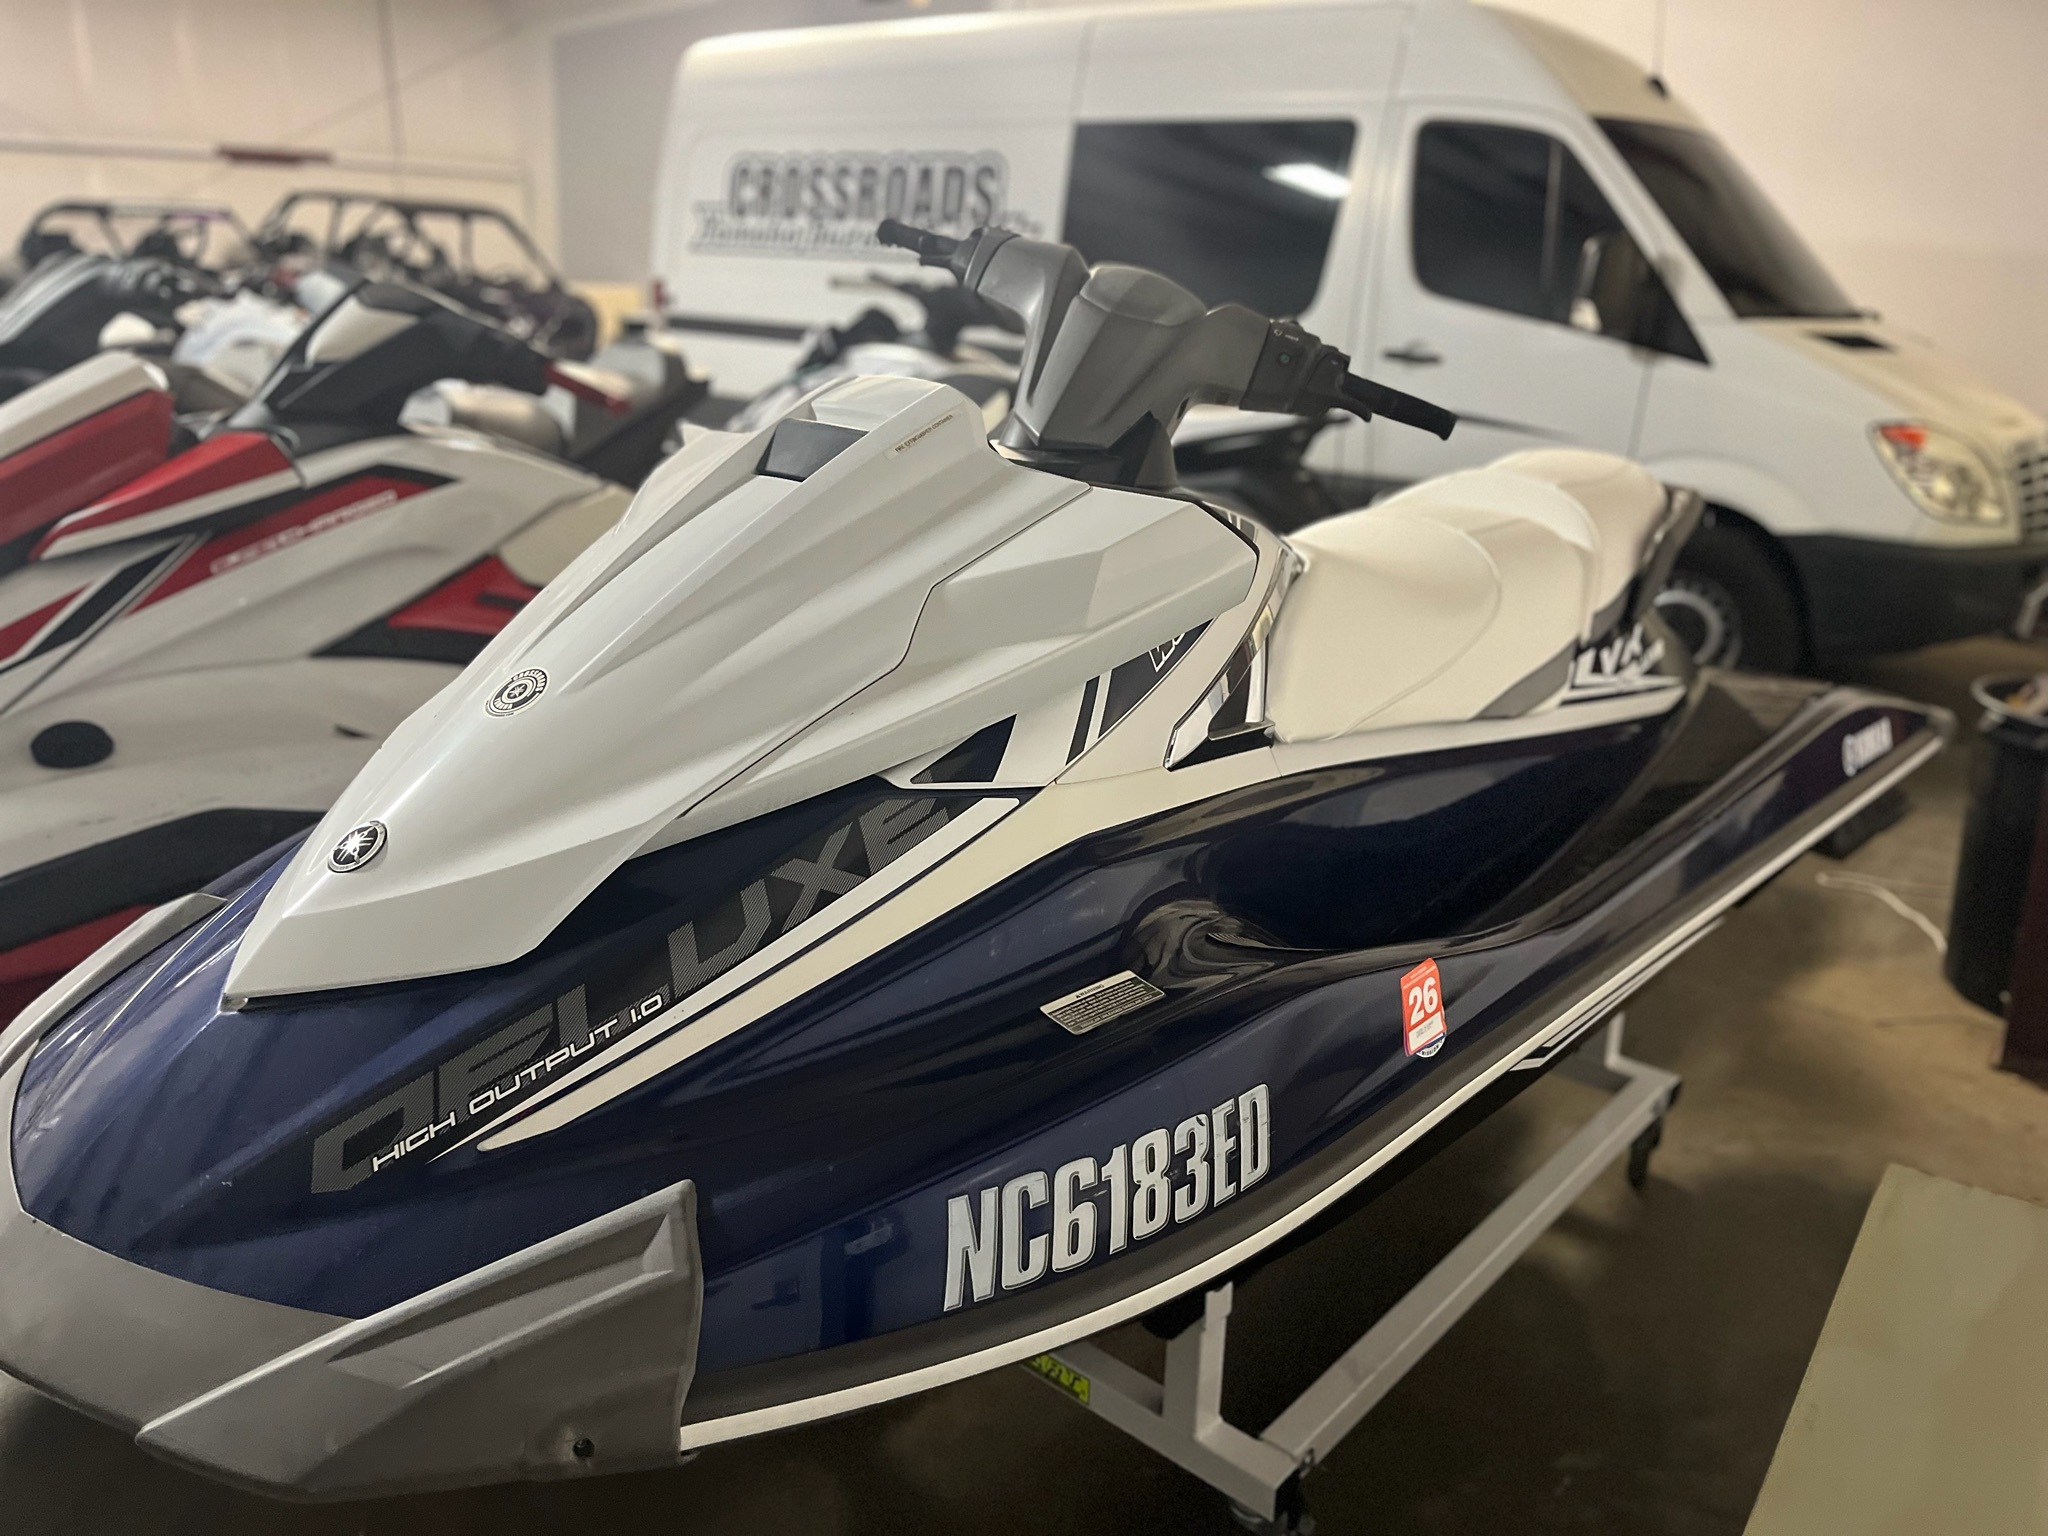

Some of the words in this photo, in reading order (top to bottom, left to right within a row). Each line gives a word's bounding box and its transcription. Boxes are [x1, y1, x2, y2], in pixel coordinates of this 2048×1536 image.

[730, 162, 998, 220] CROSSROADS
[1408, 976, 1438, 1026] 26
[372, 1111, 456, 1173] HIGH
[468, 1018, 618, 1115] OUTPUT
[630, 994, 663, 1024] 1.0
[944, 1083, 1271, 1312] NC6183ED
